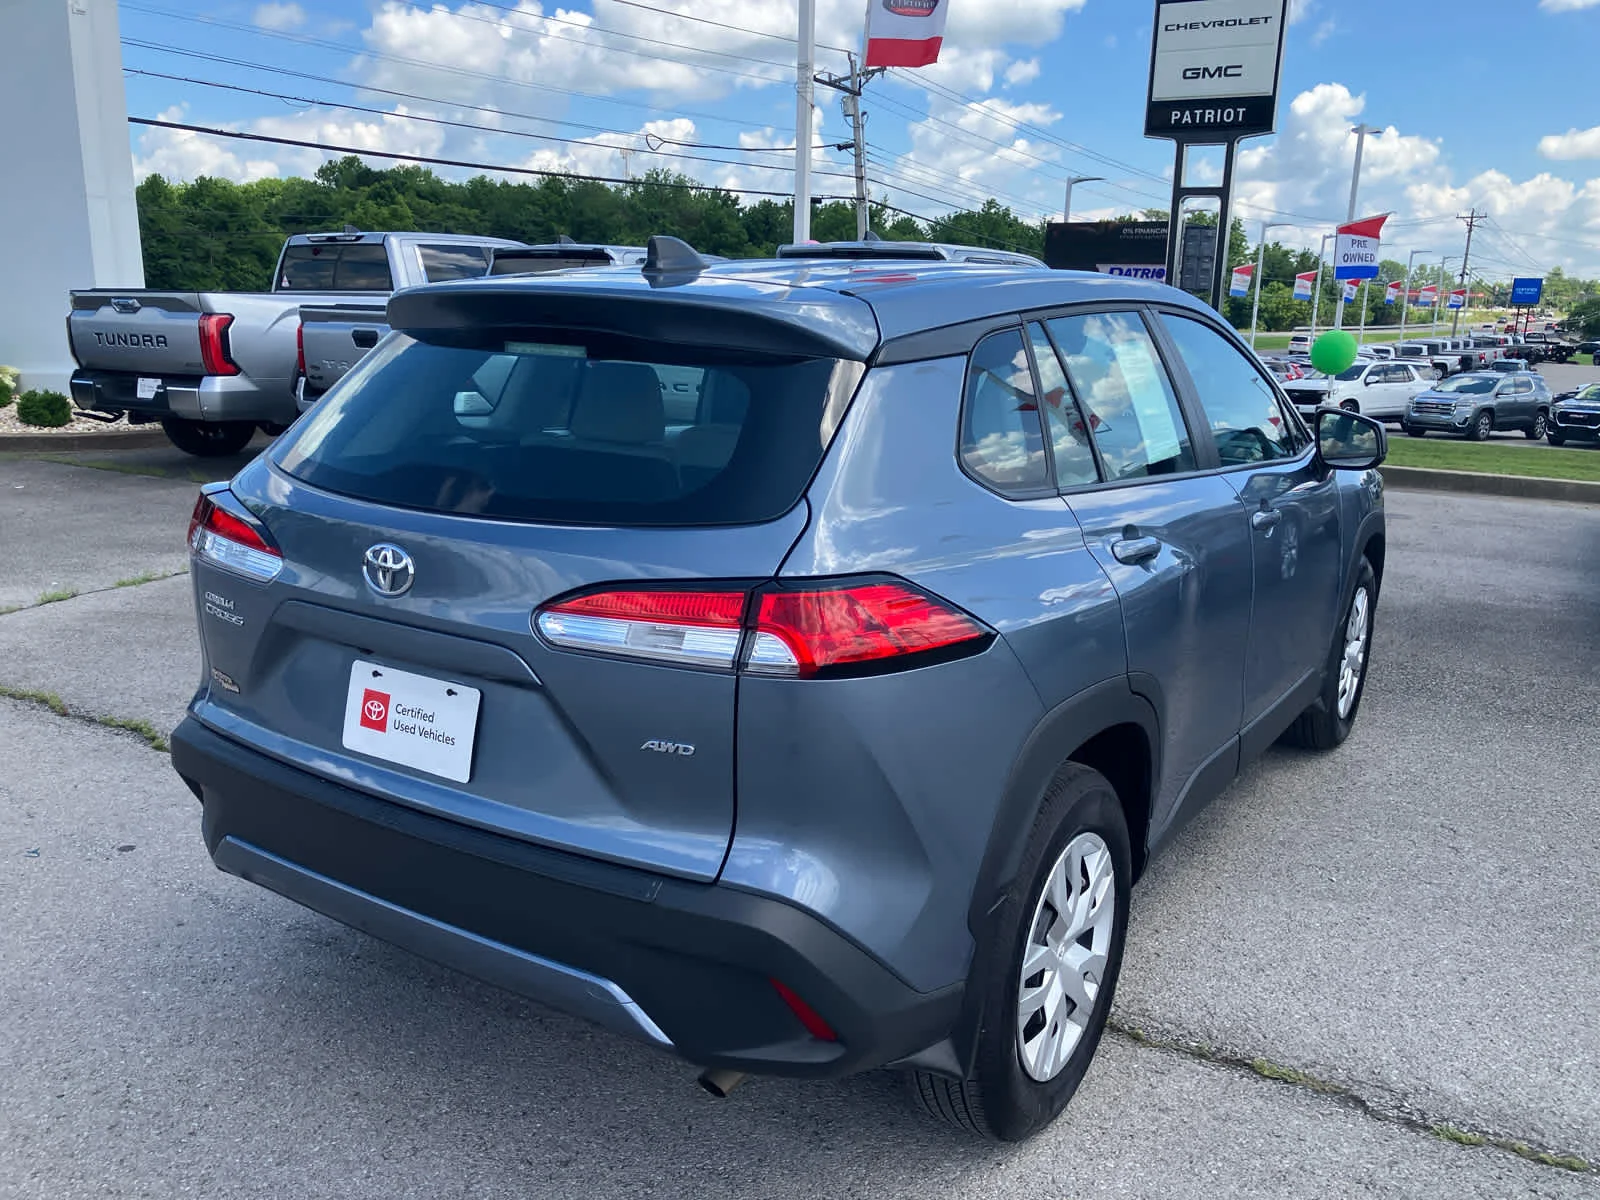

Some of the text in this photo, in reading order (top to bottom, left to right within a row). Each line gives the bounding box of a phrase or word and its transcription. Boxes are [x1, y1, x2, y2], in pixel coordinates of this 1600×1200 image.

[1164, 16, 1272, 32] CHEVROLET
[1182, 65, 1242, 80] GMC
[1170, 108, 1246, 124] PATRIOT
[1351, 239, 1368, 248] PRE
[1342, 252, 1375, 263] OWNED
[1109, 267, 1166, 279] PATRIO
[94, 332, 168, 348] TUNDRA
[206, 603, 244, 626] CROSS
[395, 703, 435, 723] Certified
[393, 719, 456, 746] Used Vehicles
[640, 740, 695, 756] AWD
